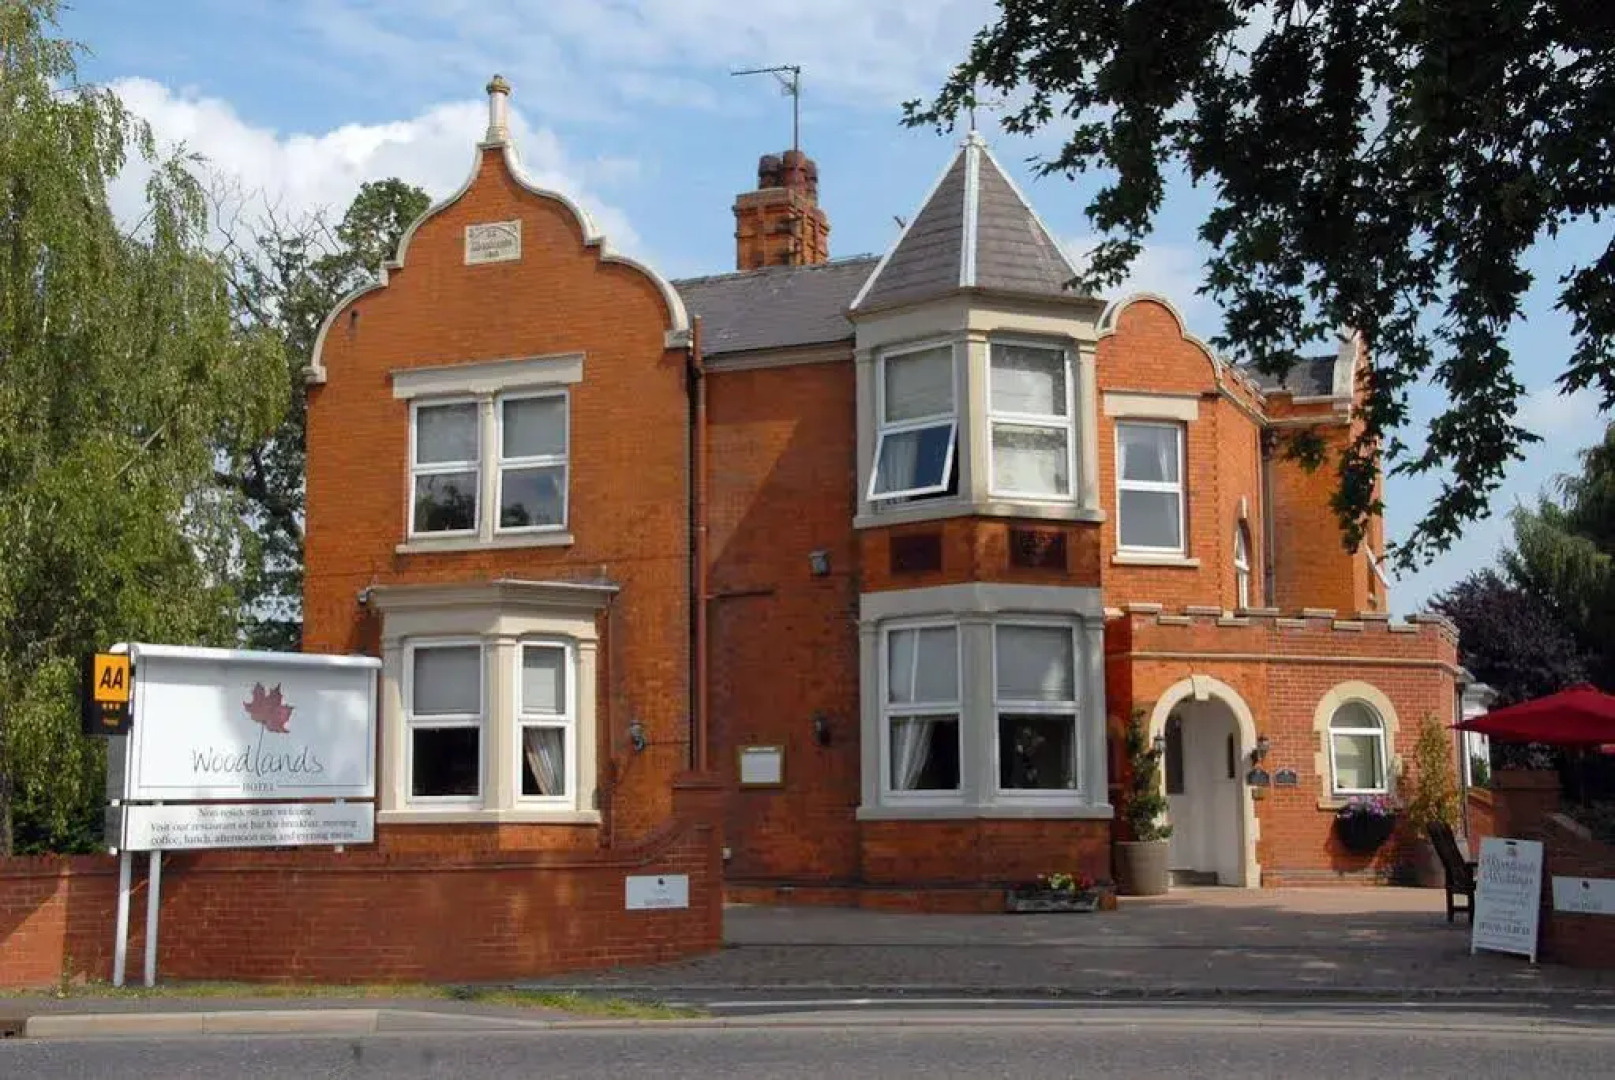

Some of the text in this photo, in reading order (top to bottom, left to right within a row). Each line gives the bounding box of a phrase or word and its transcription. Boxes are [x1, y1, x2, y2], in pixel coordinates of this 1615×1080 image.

[99, 665, 125, 690] AA
[192, 744, 324, 778] Woodlands
[242, 782, 276, 792] HOTEL
[151, 822, 170, 832] Visit
[172, 822, 189, 831] our
[191, 822, 236, 831] restaurant
[214, 833, 258, 843] afternoon
